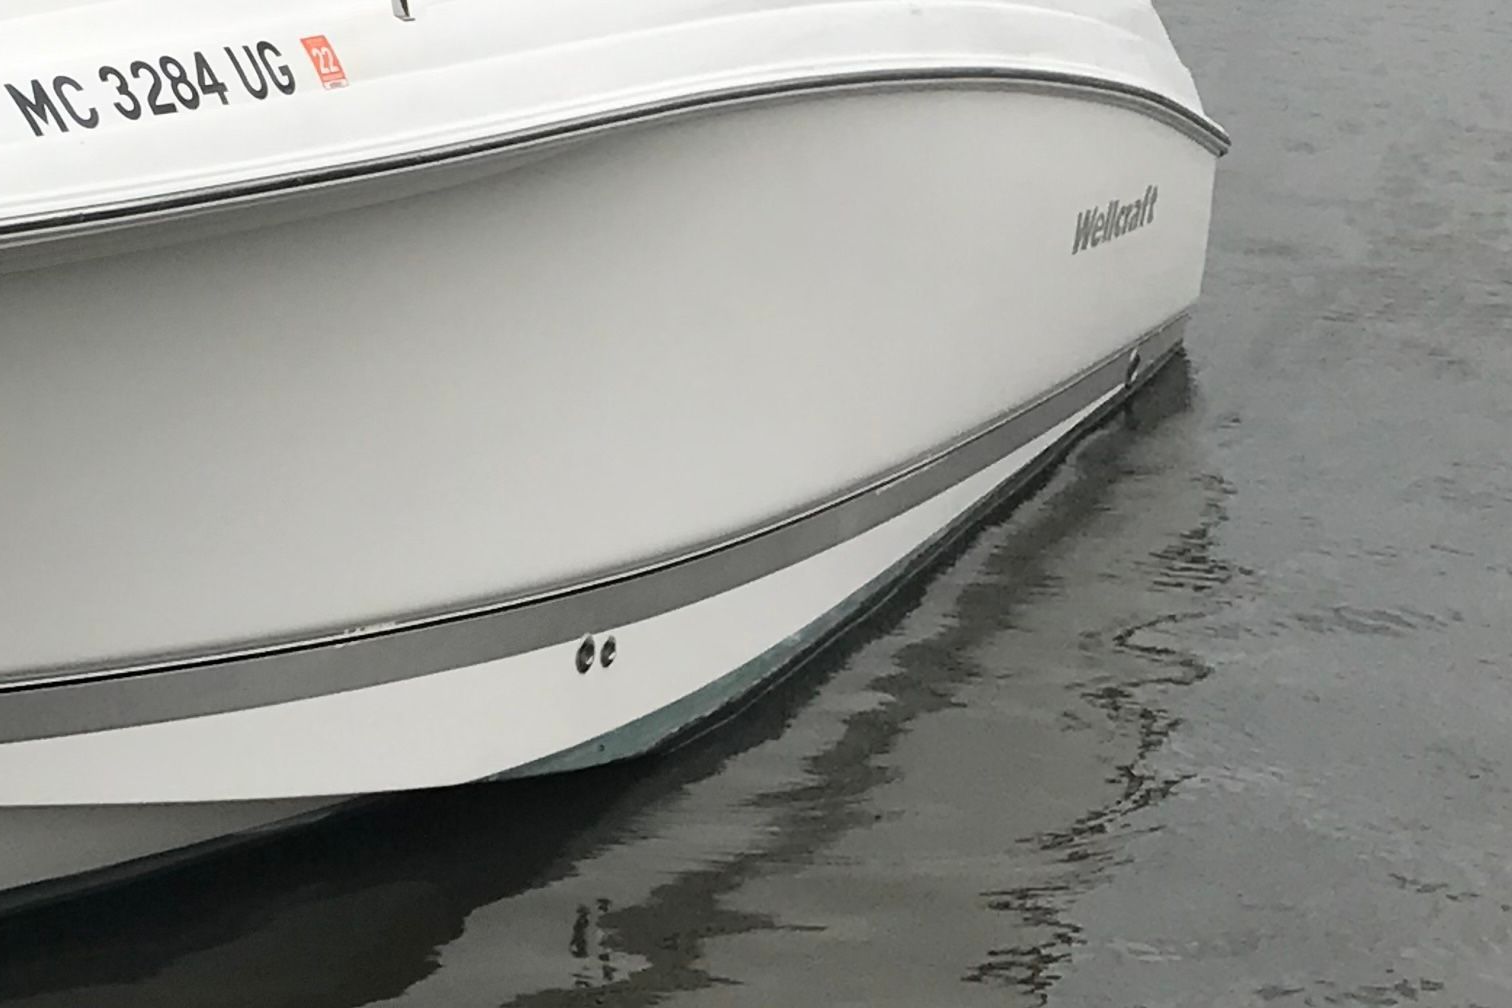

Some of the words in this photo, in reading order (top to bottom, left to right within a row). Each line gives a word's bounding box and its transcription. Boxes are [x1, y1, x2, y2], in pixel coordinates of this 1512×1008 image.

[3, 75, 100, 137] MC
[98, 51, 230, 121] 3284
[223, 40, 296, 100] UG
[311, 46, 341, 74] 22
[1071, 184, 1158, 255] Wellcraft
